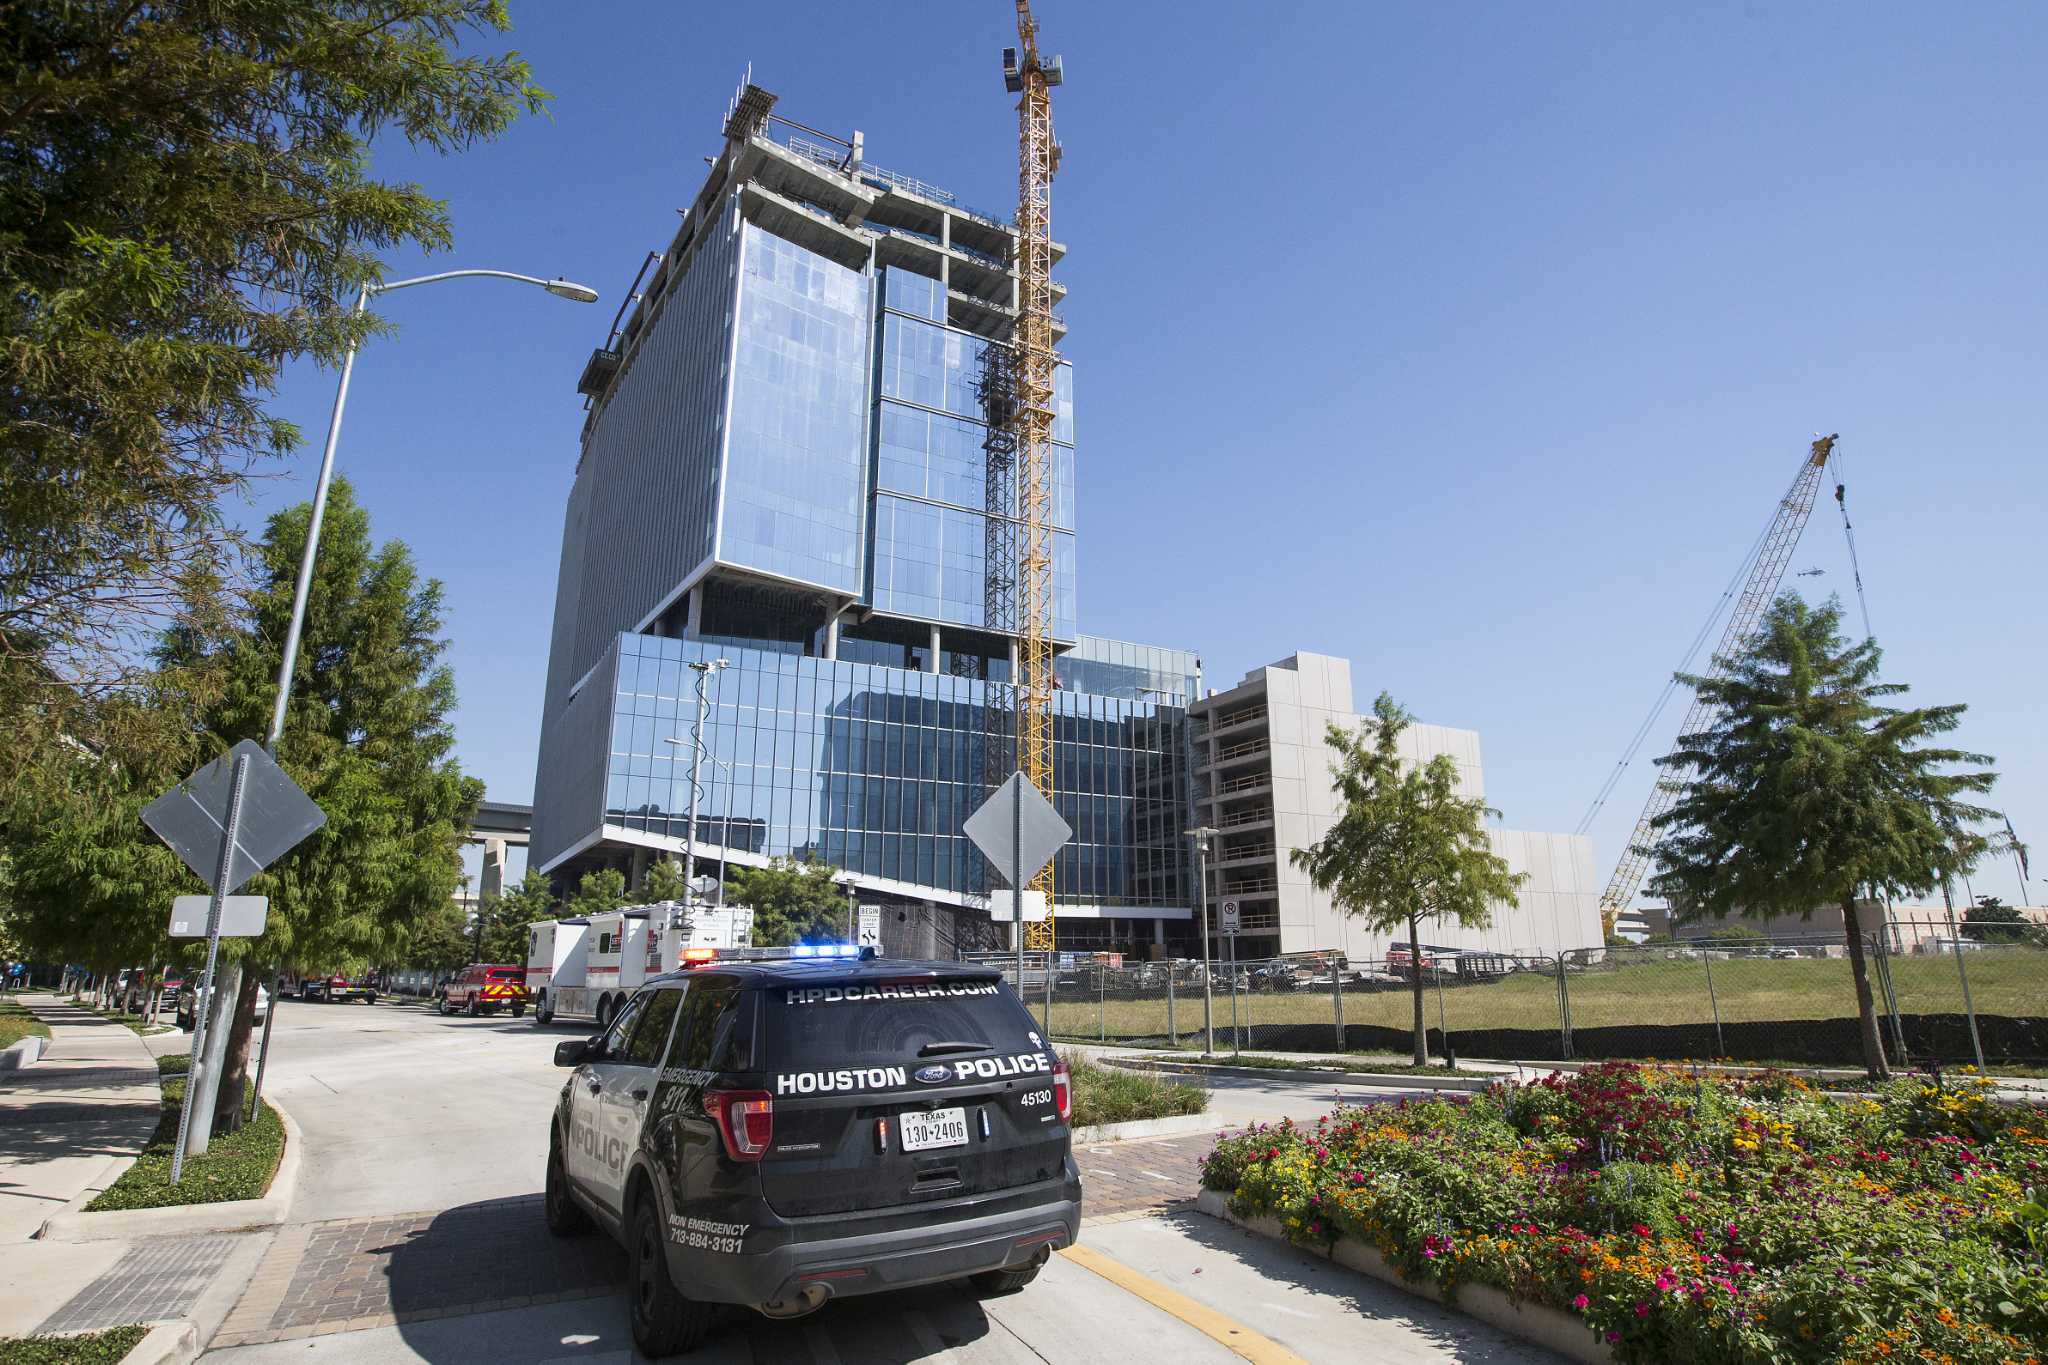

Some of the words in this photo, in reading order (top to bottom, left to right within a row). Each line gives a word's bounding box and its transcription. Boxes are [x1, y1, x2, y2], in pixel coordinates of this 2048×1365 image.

[786, 982, 999, 1005] HPDCAREER.COM
[659, 1067, 720, 1088] EMERGENCY
[777, 1066, 907, 1095] HOUSTON
[923, 1069, 945, 1080] Ford
[954, 1052, 1051, 1081] POLICE
[662, 1085, 689, 1113] 911
[1020, 1089, 1052, 1107] 45130
[920, 1111, 946, 1121] TEXAS
[934, 1121, 964, 1140] 2406
[669, 1213, 687, 1227] NON
[687, 1217, 750, 1237] EMERGENCY
[670, 1227, 744, 1254] 713-884-3131
